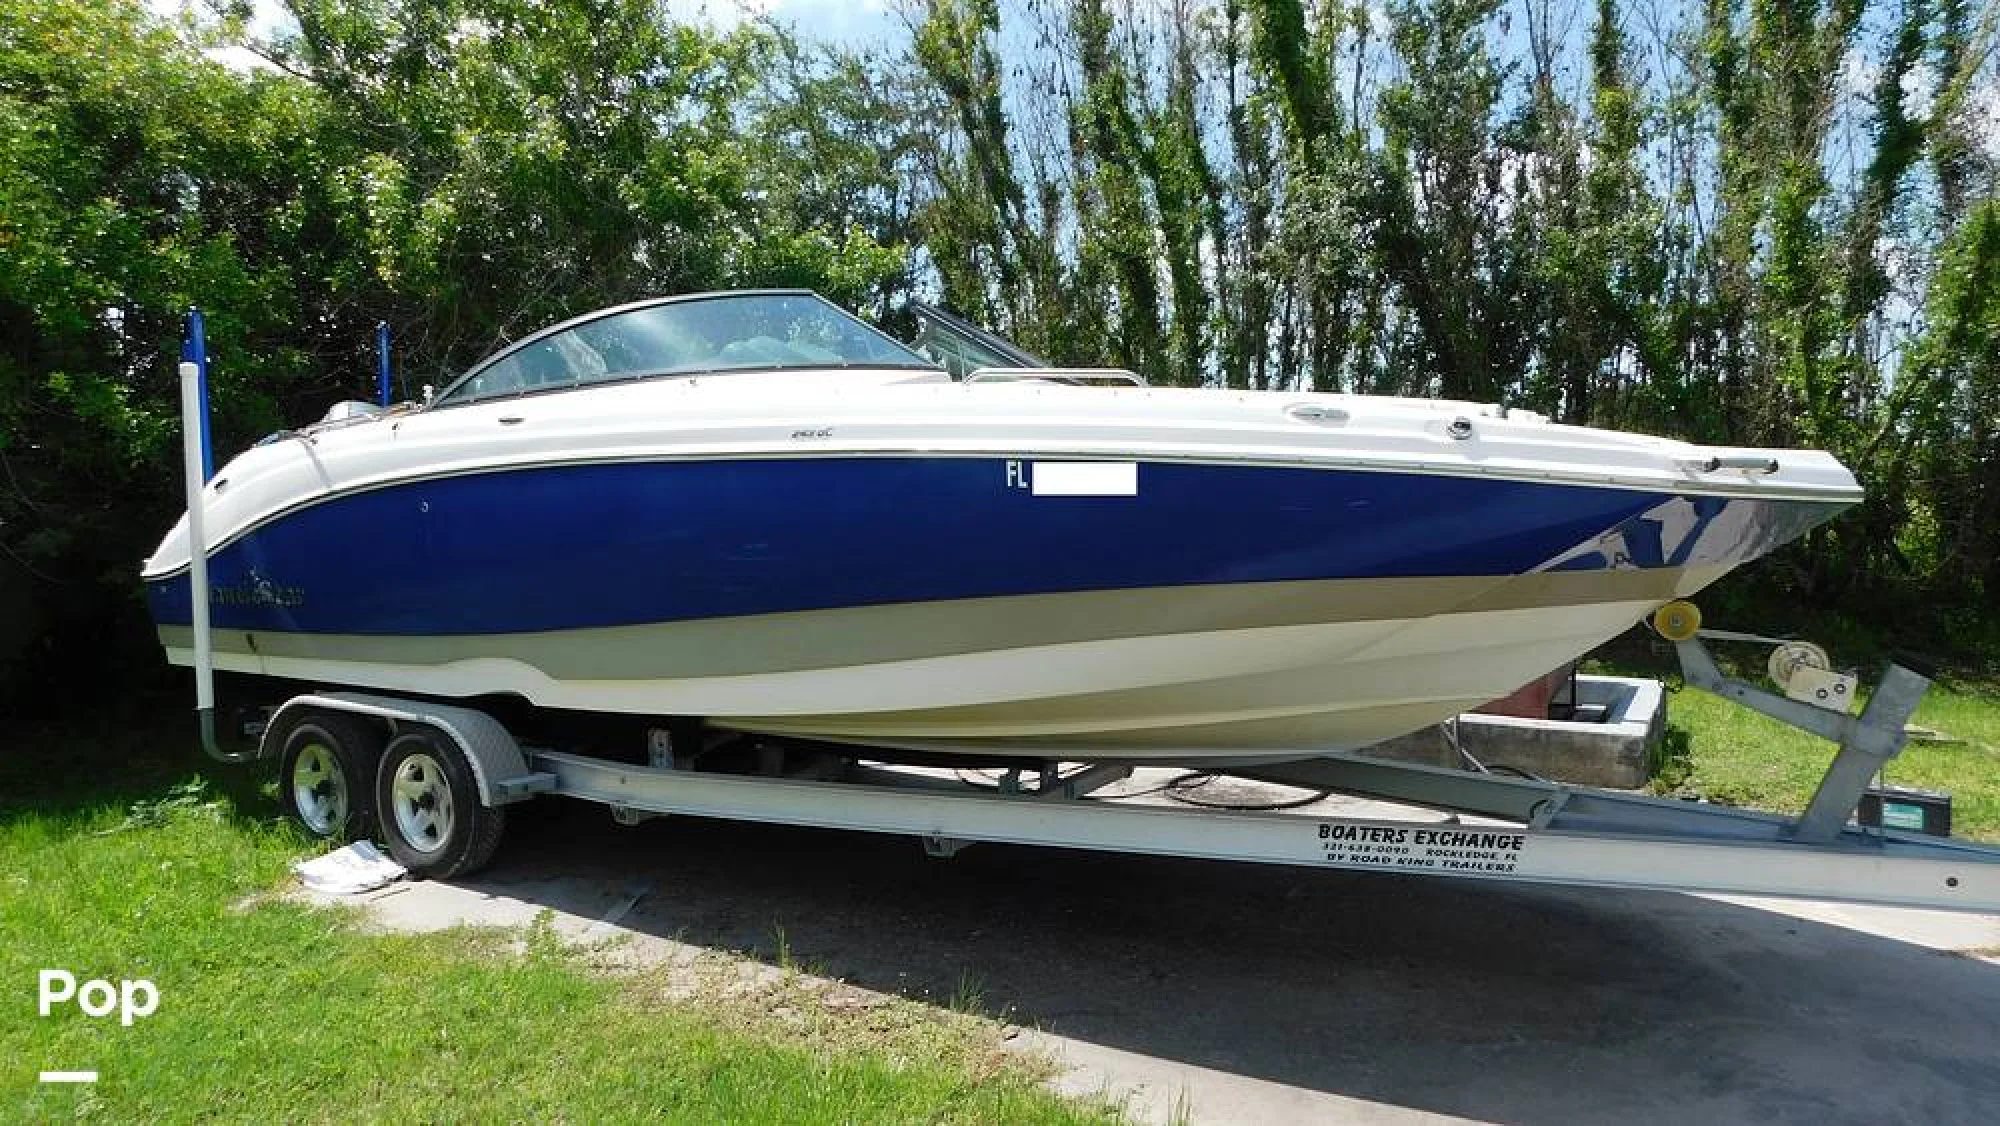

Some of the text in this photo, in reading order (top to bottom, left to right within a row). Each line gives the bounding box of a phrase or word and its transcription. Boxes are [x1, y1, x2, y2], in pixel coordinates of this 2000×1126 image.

[1006, 461, 1028, 488] FL
[1320, 825, 1524, 850] BOATERS EXCHANGE
[1327, 853, 1516, 872] BY ROAD KING TRAILERS
